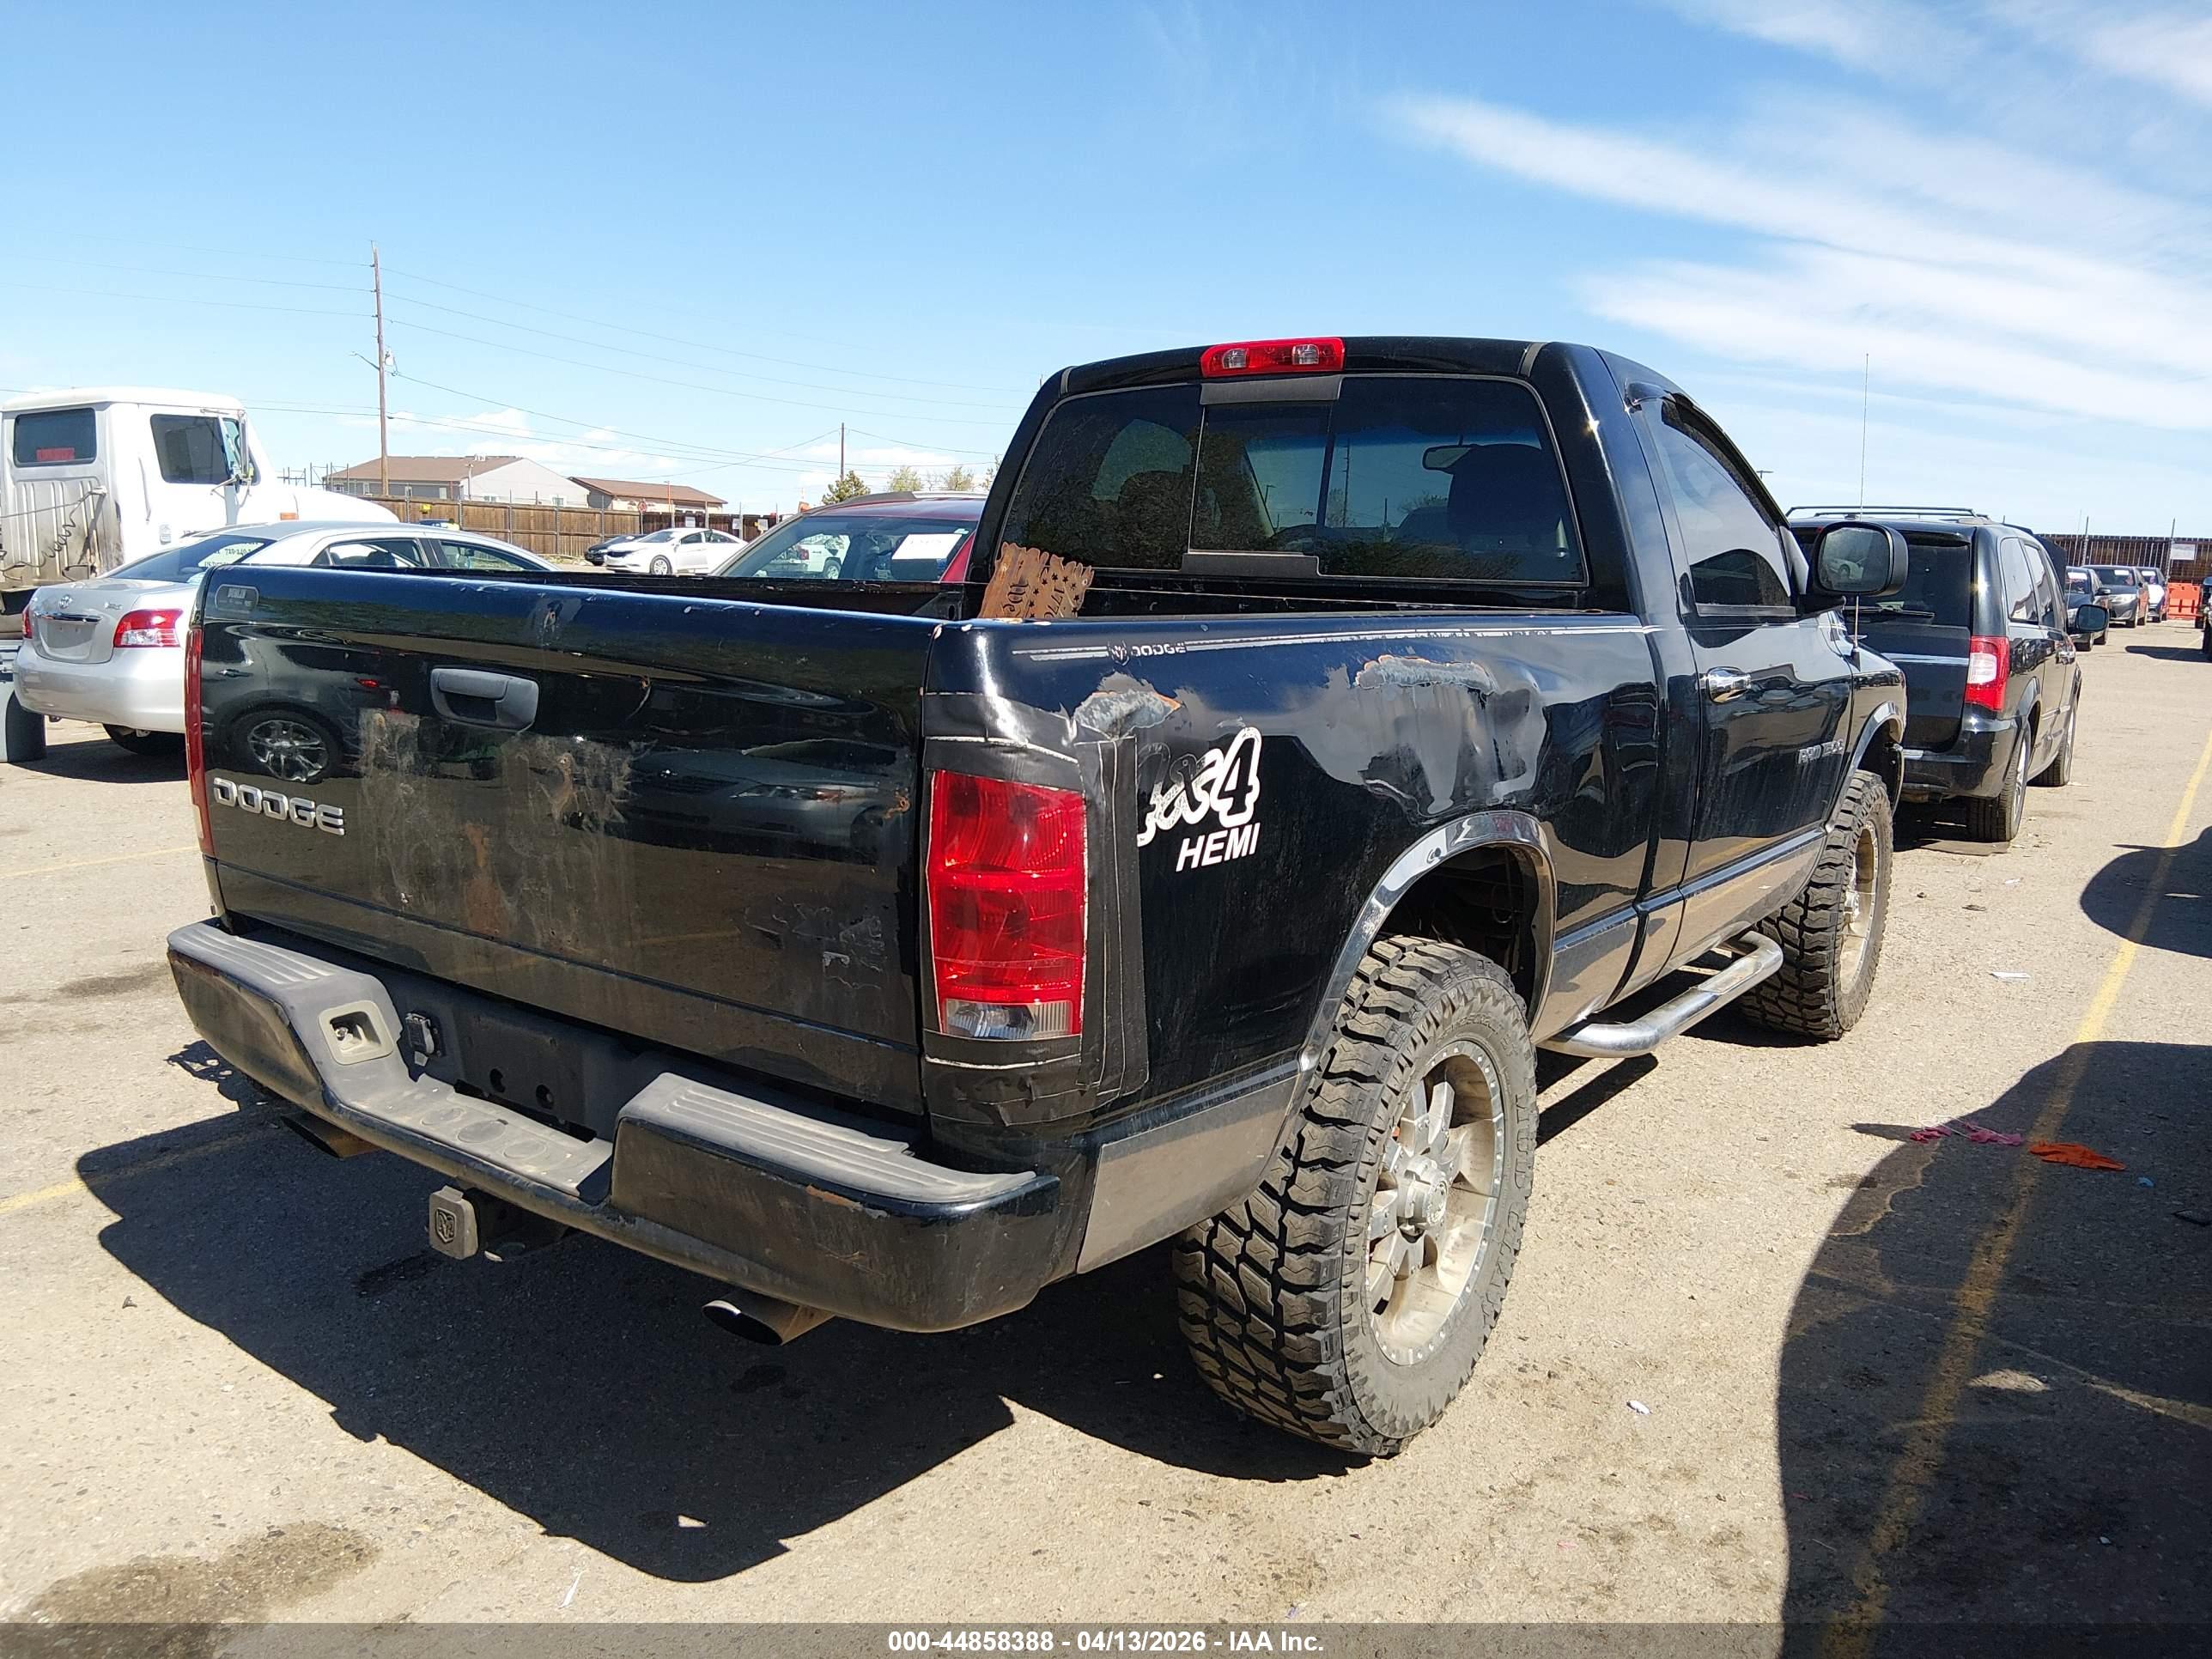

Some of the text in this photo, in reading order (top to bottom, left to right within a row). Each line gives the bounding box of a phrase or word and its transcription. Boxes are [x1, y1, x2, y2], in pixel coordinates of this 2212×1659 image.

[1130, 641, 1188, 658] DODGE
[213, 777, 345, 837] DODGE
[1176, 822, 1261, 873] HEMI
